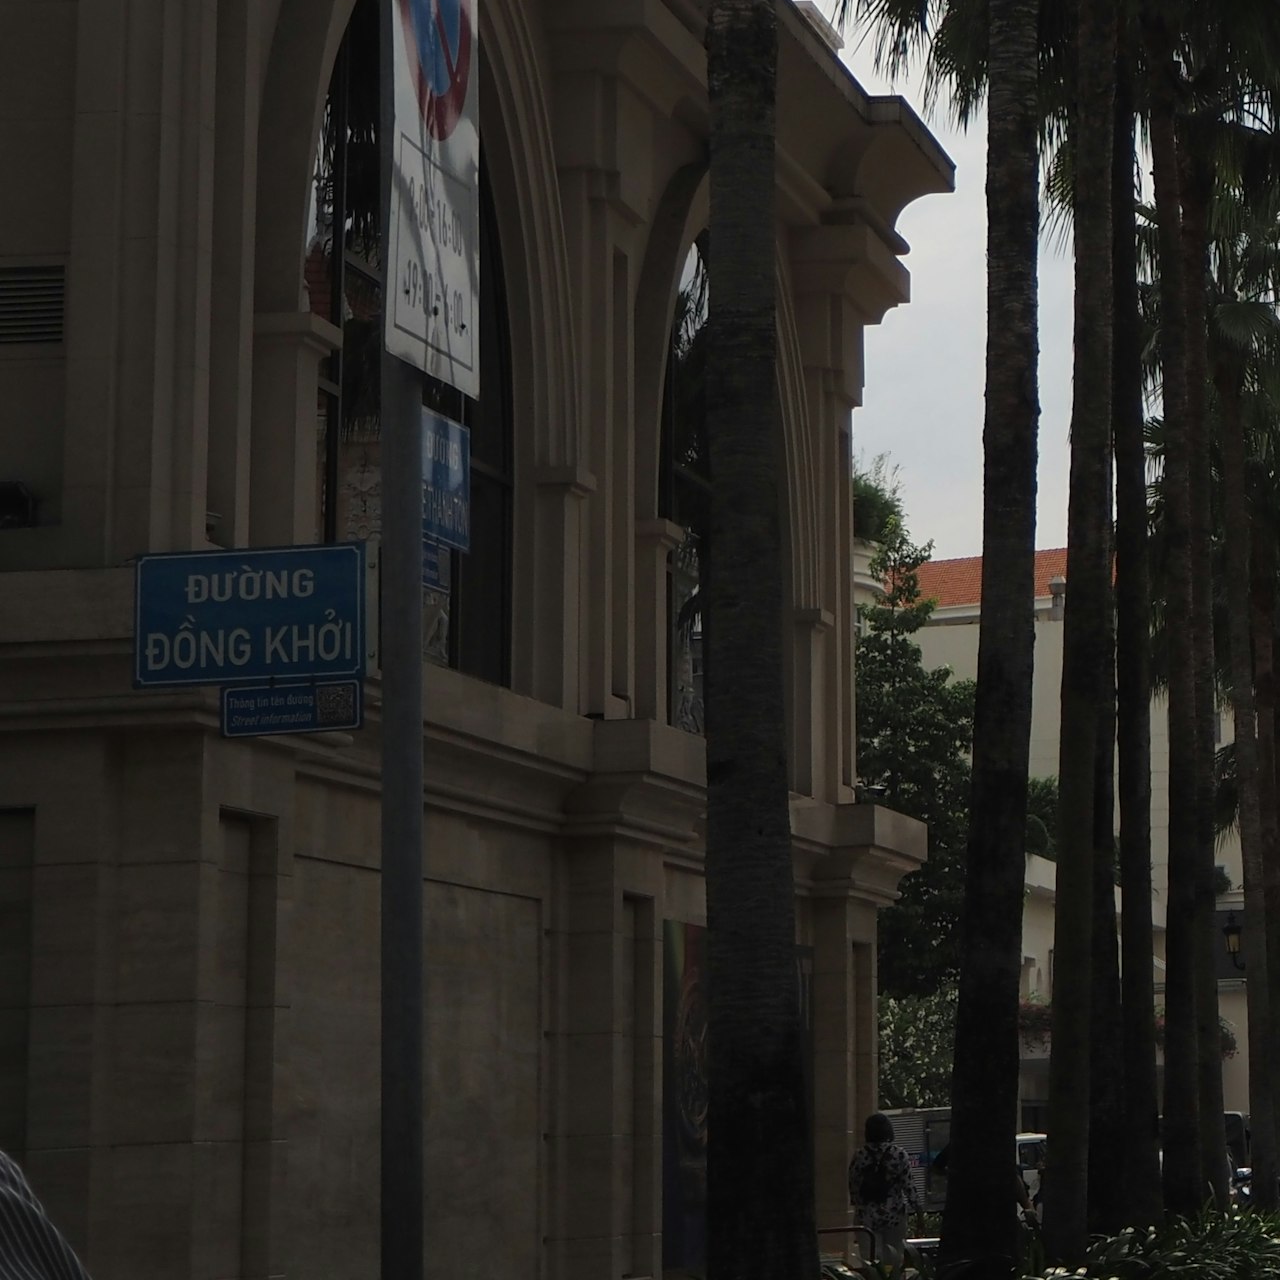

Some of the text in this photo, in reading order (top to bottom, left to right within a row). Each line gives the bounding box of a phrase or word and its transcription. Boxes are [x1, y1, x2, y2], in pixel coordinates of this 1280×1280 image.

[185, 565, 314, 603] ĐƯỜNG
[145, 608, 352, 671] ĐỒNG KHỞI
[229, 693, 314, 710] Thông tin tên đường
[231, 712, 312, 726] Street information
